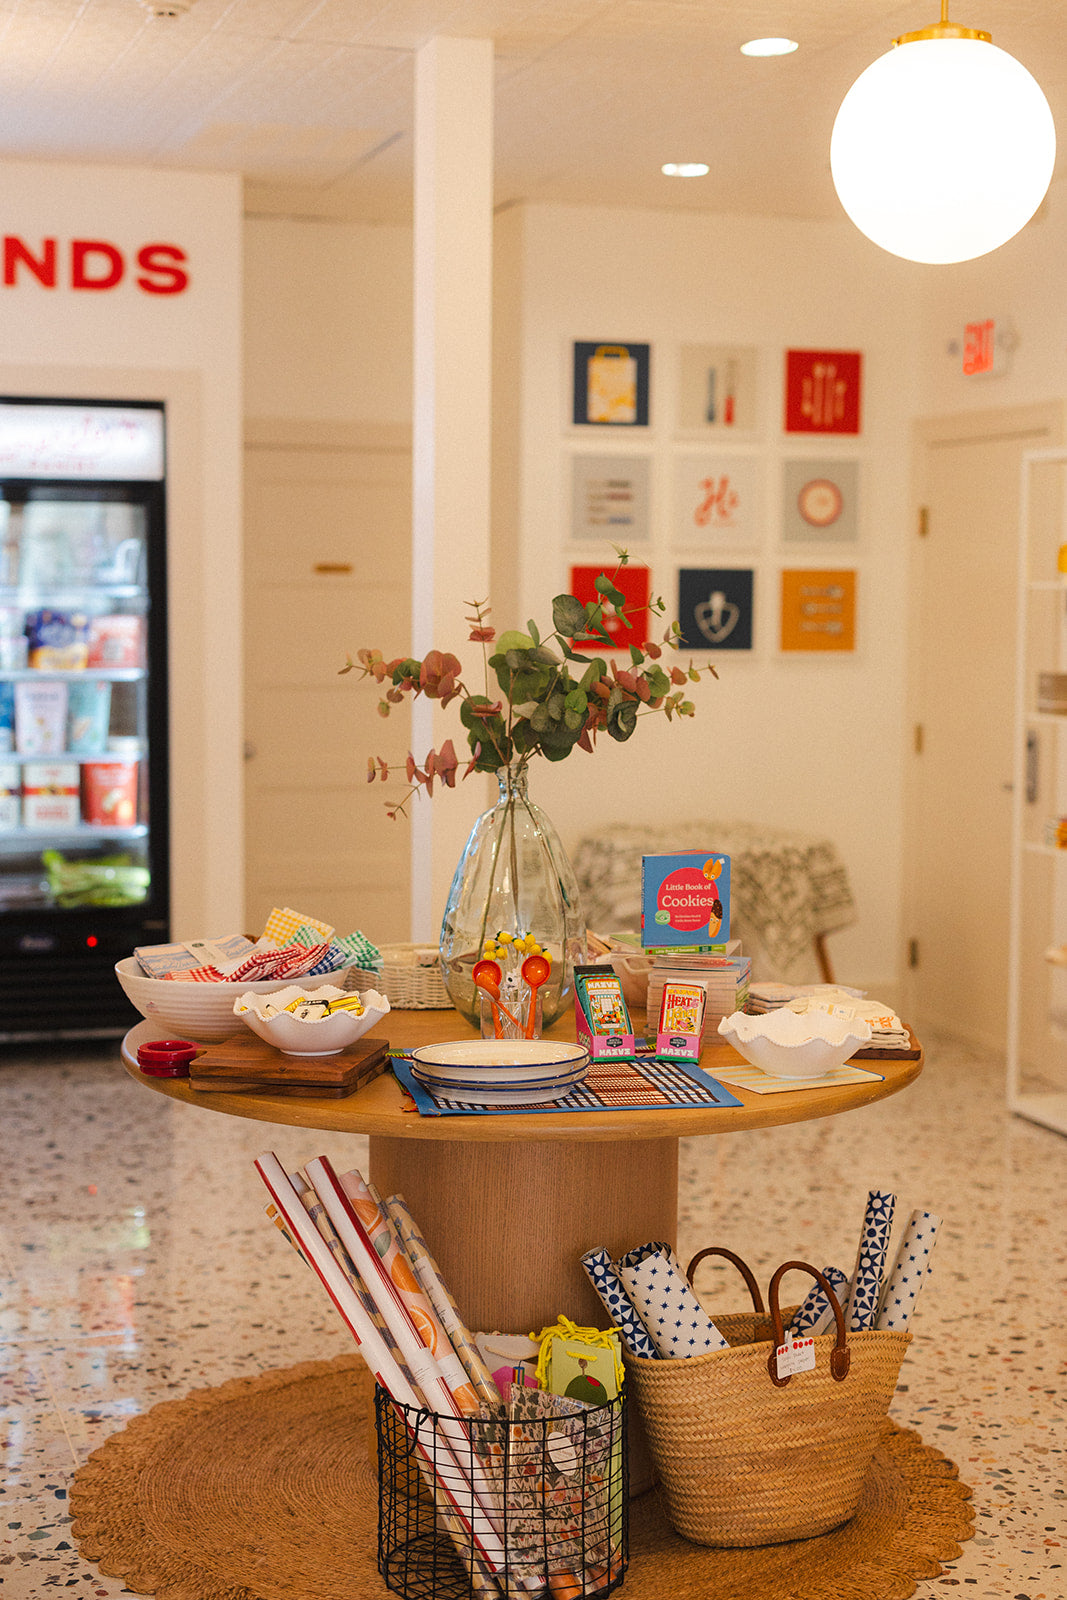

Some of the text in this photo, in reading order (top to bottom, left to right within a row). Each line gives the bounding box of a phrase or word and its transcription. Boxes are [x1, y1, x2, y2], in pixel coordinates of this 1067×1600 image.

[3, 235, 189, 296] NDS
[665, 883, 684, 891] Little
[685, 883, 703, 891] Book
[661, 894, 714, 907] Cookies
